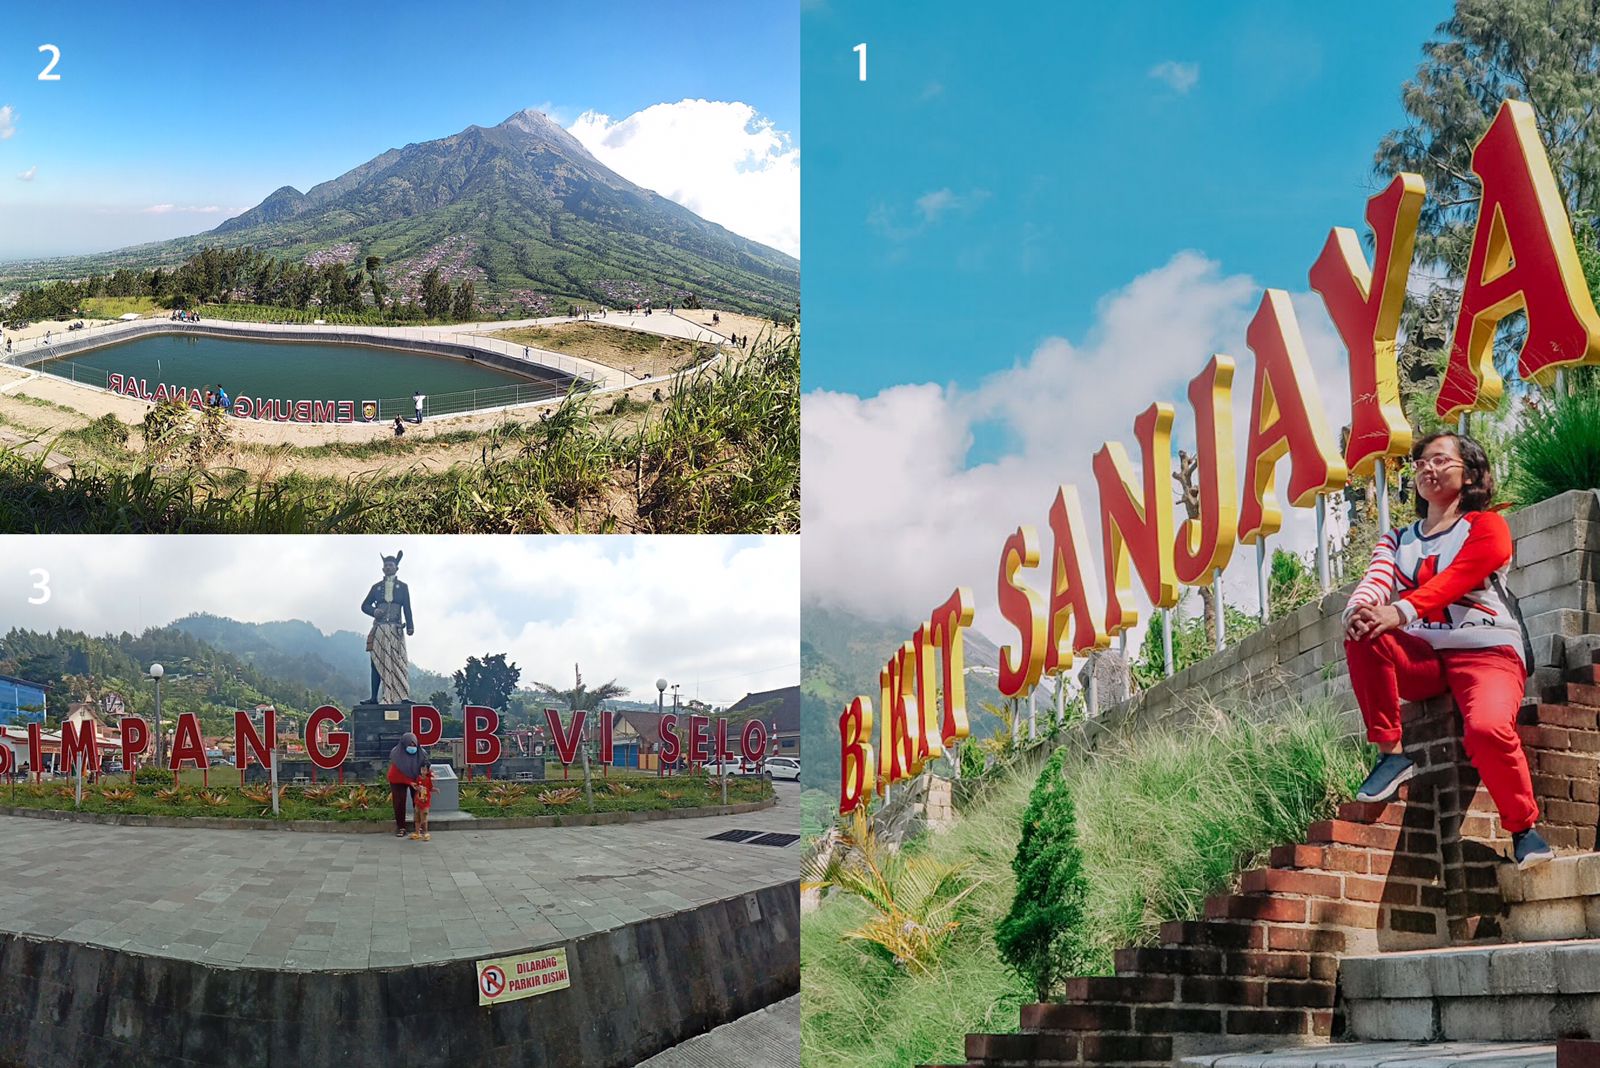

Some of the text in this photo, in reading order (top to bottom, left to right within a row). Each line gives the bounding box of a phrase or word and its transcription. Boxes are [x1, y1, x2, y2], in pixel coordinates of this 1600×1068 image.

[998, 99, 1600, 698] SANJAYA
[411, 705, 502, 766] PB
[544, 708, 614, 765] VI
[658, 714, 768, 765] SELO
[509, 974, 541, 992] PARKIR
[516, 956, 557, 974] DILARANG
